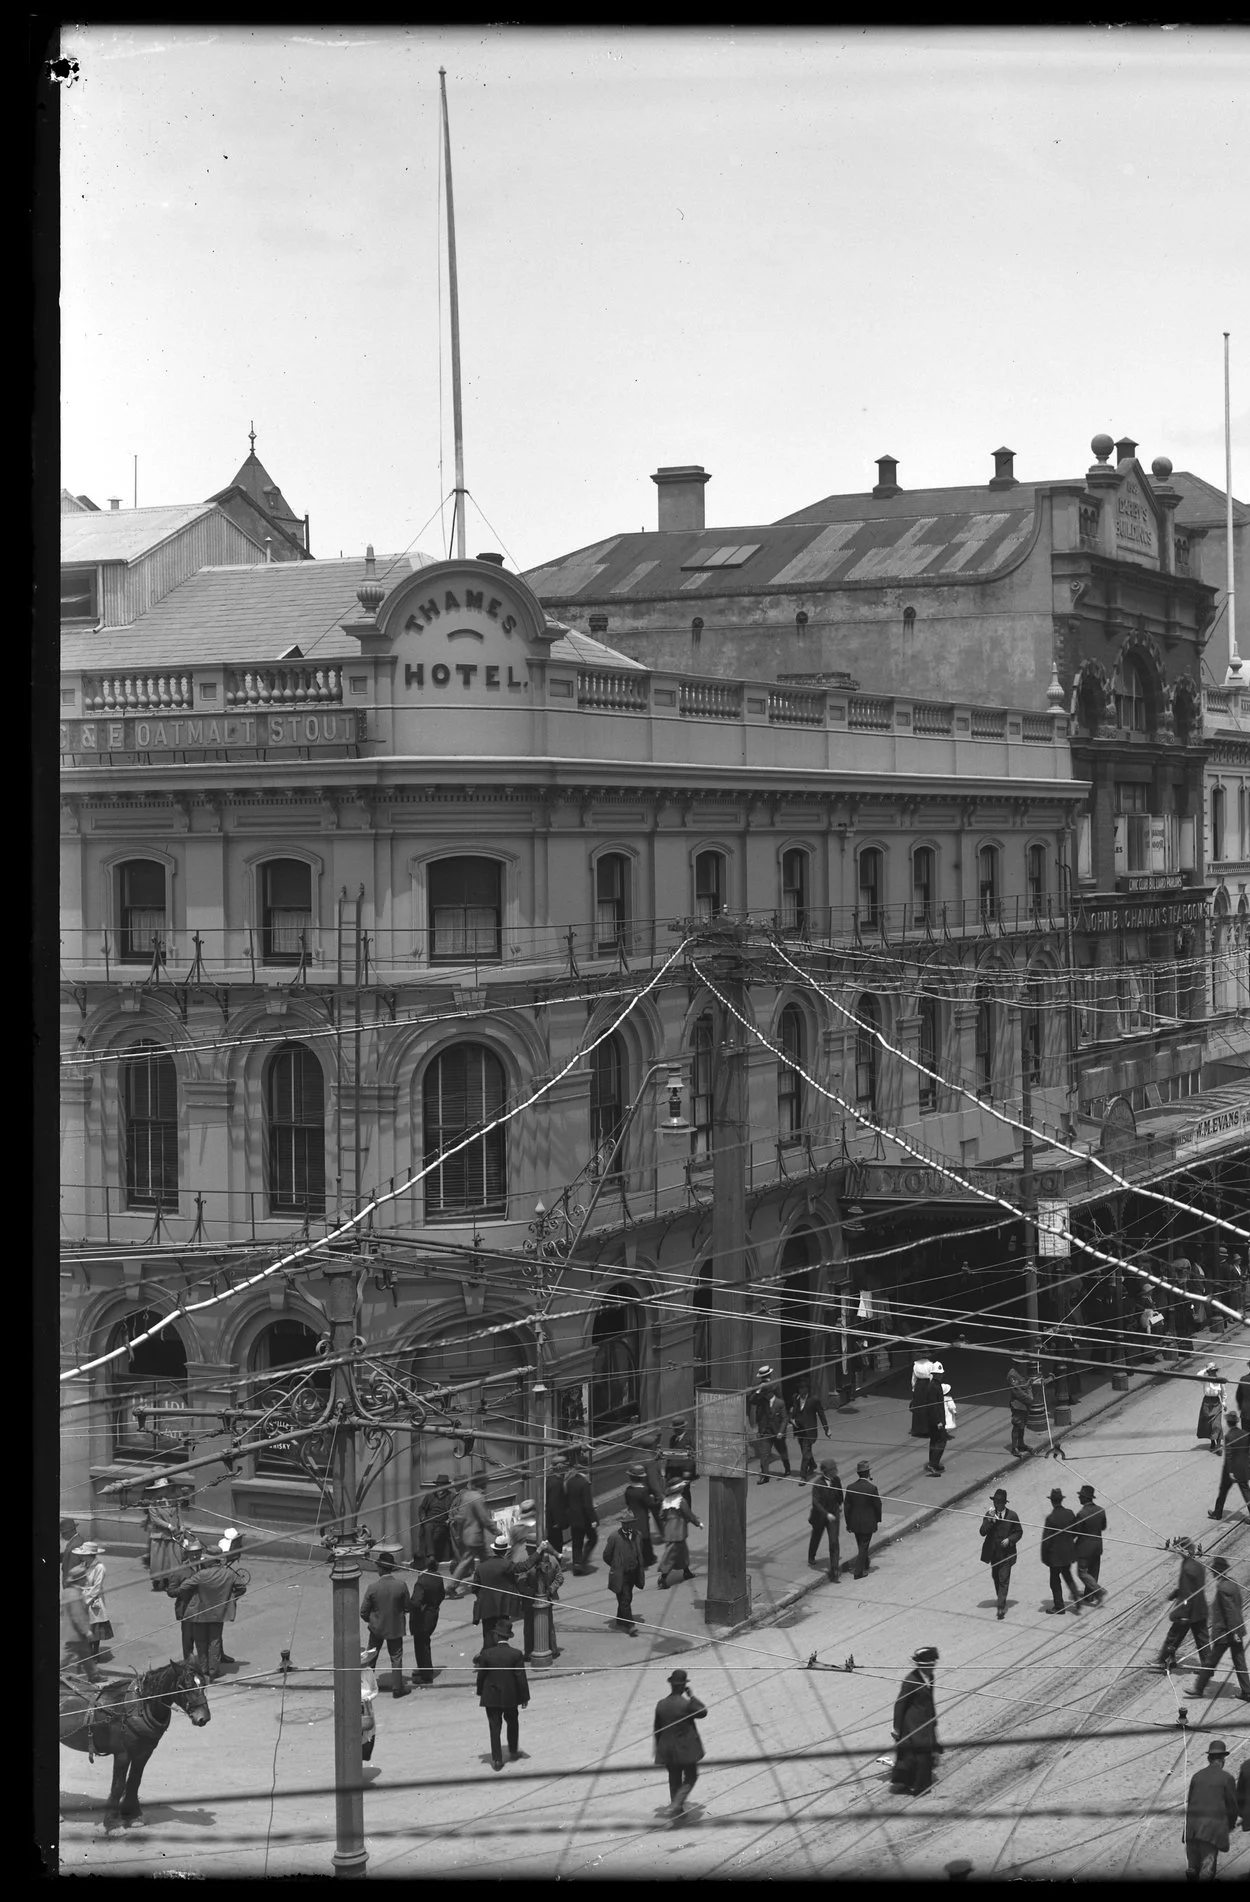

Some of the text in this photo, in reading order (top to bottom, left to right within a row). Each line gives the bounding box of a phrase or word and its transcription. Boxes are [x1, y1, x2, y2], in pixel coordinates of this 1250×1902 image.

[404, 588, 517, 635] THAMES
[108, 724, 122, 747] E
[136, 718, 254, 746] OATMALT
[269, 713, 354, 742] STOUT
